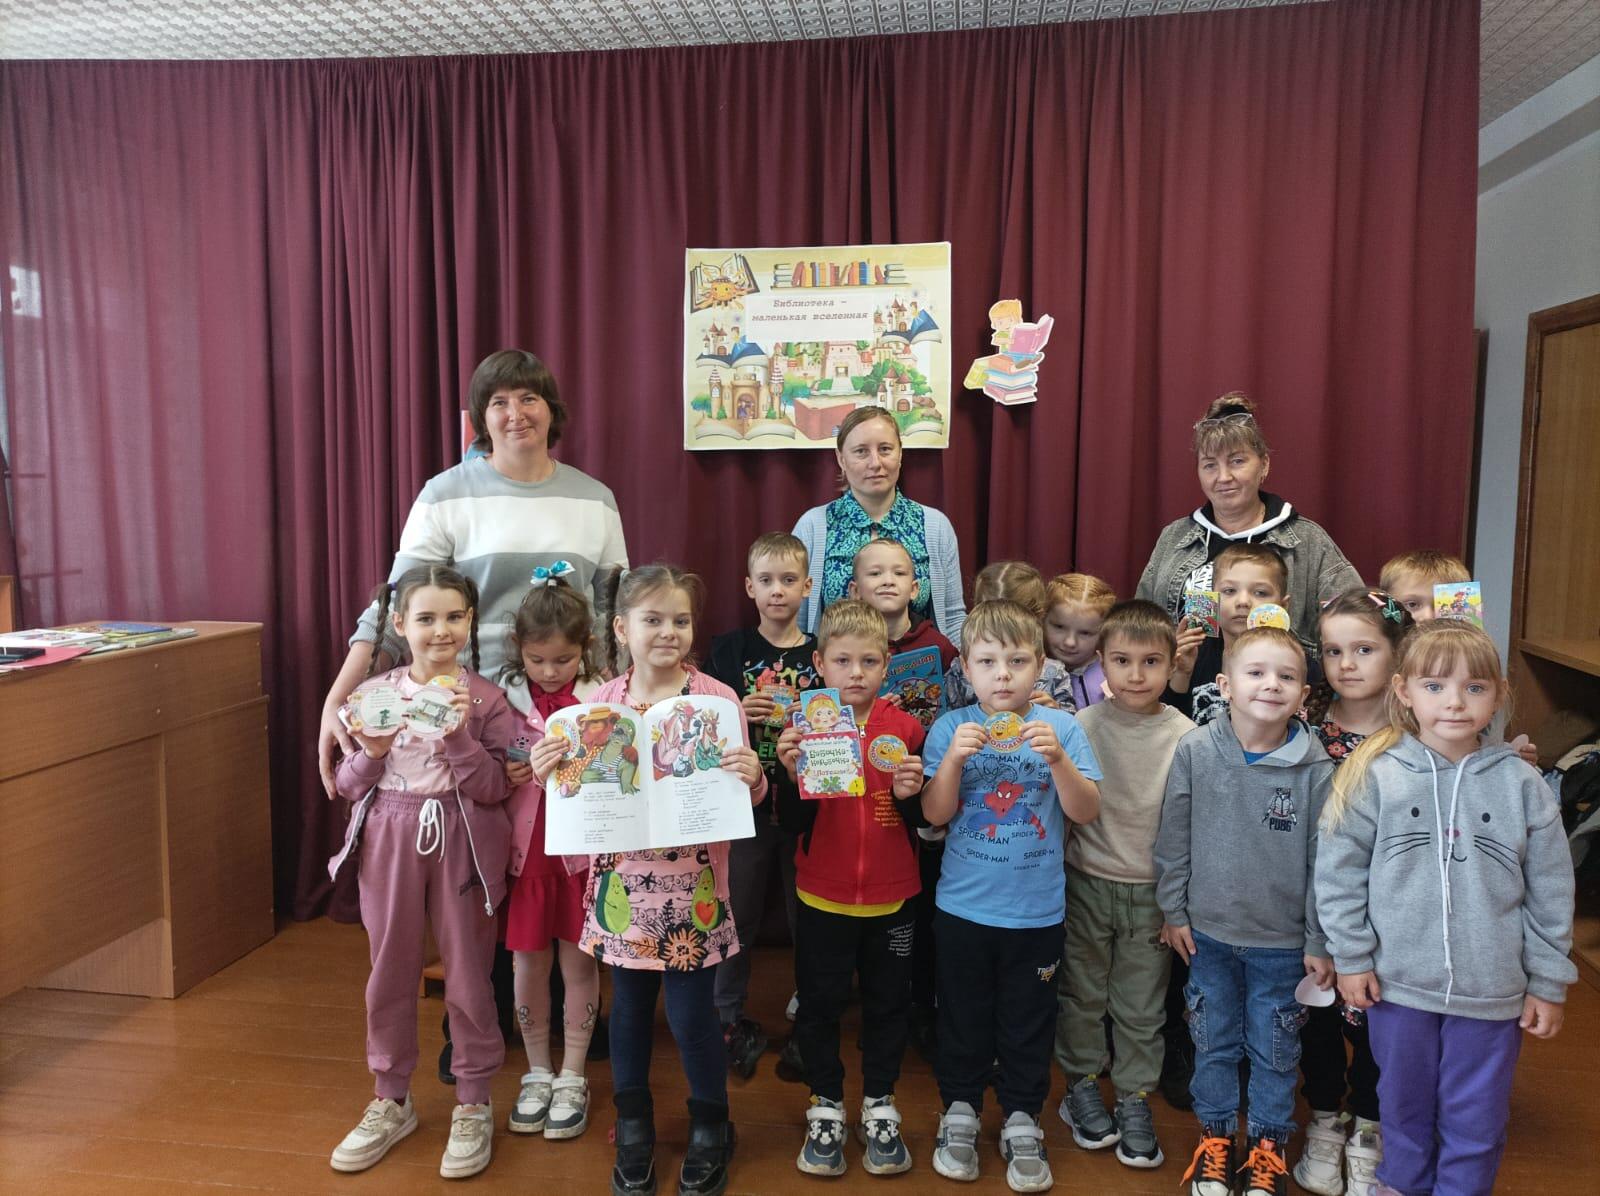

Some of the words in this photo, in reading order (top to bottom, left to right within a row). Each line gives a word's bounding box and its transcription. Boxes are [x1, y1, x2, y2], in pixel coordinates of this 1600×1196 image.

[773, 298, 834, 308] Библиотека
[752, 313, 807, 321] маленькая
[813, 312, 868, 320] вселенная
[1269, 817, 1292, 832] PUBG
